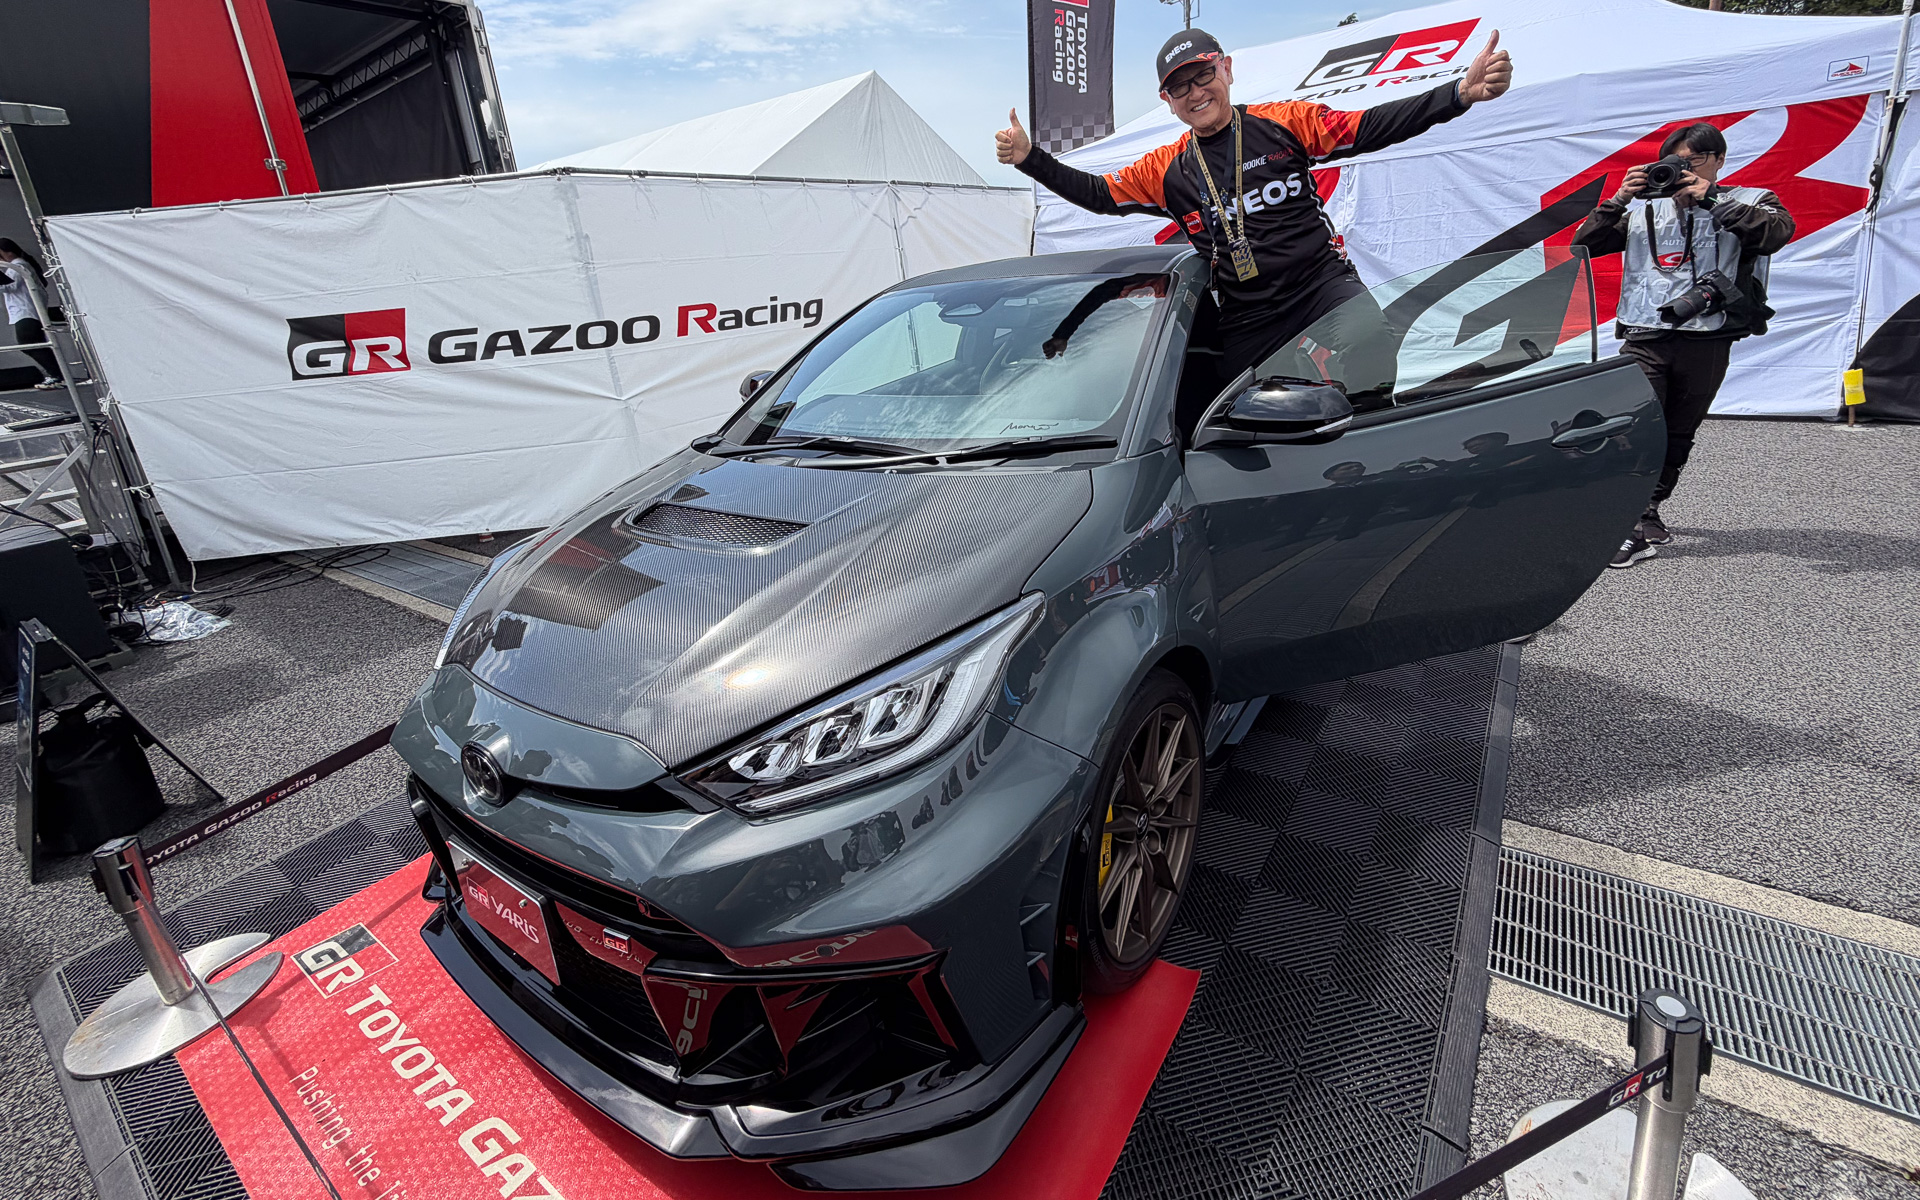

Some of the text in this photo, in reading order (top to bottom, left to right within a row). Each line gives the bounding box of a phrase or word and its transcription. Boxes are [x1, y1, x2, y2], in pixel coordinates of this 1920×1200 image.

[1053, 8, 1066, 83] Racing
[1065, 10, 1076, 86] GAZOO
[1078, 12, 1088, 94] TOYOTA
[1165, 40, 1193, 63] ENEOS
[1304, 39, 1461, 87] GR
[1375, 65, 1470, 88] Raci
[1242, 155, 1267, 172] ROOKIE
[292, 296, 823, 376] GR GAZOO Racing
[204, 801, 263, 835] GAZOO
[265, 773, 318, 804] Racing
[469, 885, 491, 909] GR
[604, 937, 630, 953] GR
[300, 941, 365, 994] GR
[345, 984, 475, 1127] TOYOTA
[1608, 1081, 1640, 1106] GR
[289, 1066, 352, 1150] Pushing
[345, 1143, 382, 1187] the
